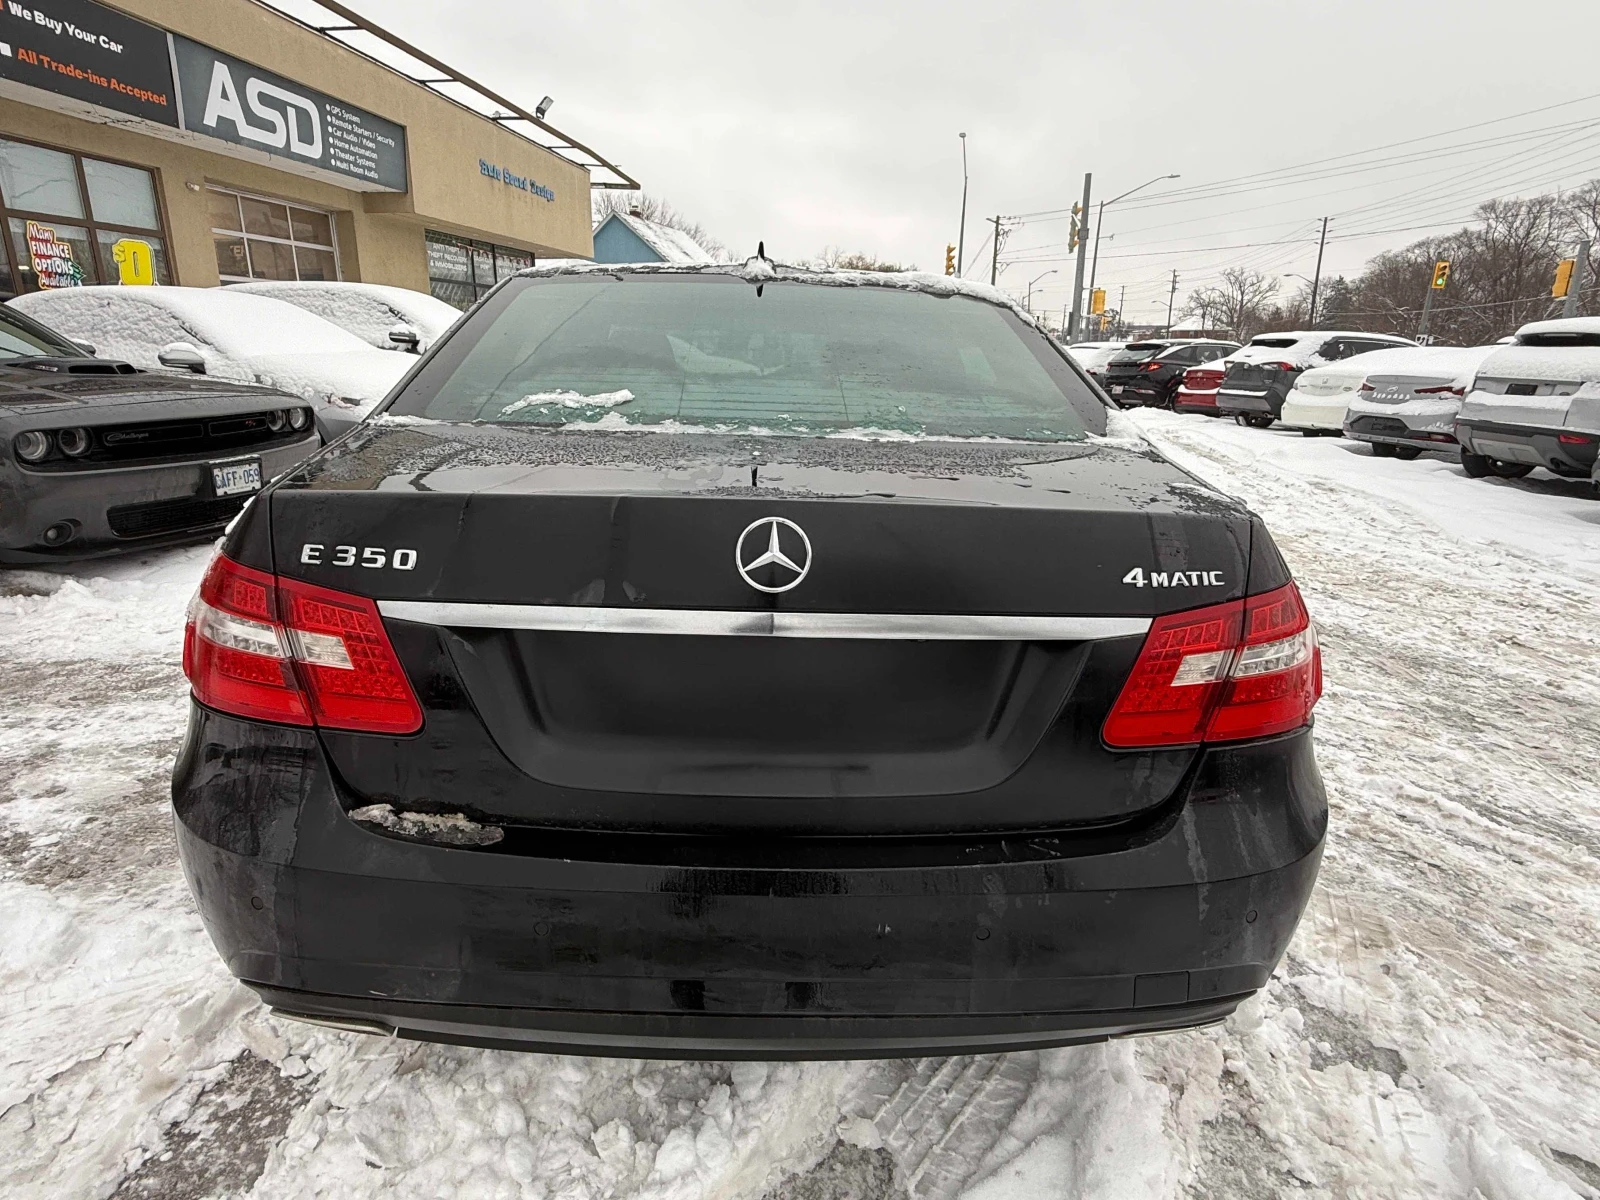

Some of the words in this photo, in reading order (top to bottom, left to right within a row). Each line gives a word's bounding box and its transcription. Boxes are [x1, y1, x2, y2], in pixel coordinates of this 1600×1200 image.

[8, 1, 32, 21] We
[34, 10, 63, 35] Buy
[64, 21, 97, 45] Your
[99, 35, 124, 54] Car
[17, 48, 37, 65] All
[39, 55, 108, 87] Trade-ins
[110, 78, 167, 106] Accepted
[203, 60, 322, 159] ASD
[331, 105, 342, 116] GPS
[332, 115, 352, 131] Remote
[353, 124, 373, 139] Starters
[376, 133, 395, 148] Security
[333, 127, 343, 137] Car
[343, 131, 358, 144] Audio
[361, 138, 376, 149] Video
[334, 138, 350, 150] Home
[350, 144, 378, 160] Automation
[335, 149, 356, 161] Theater
[356, 156, 376, 169] Systems
[336, 160, 350, 170] Multi
[350, 164, 365, 174] Room
[365, 169, 379, 179] Audio
[29, 224, 54, 244] Many
[31, 241, 71, 258] FINANCE
[34, 257, 74, 275] OPTIONS
[301, 543, 325, 565] E
[332, 545, 418, 571] 350
